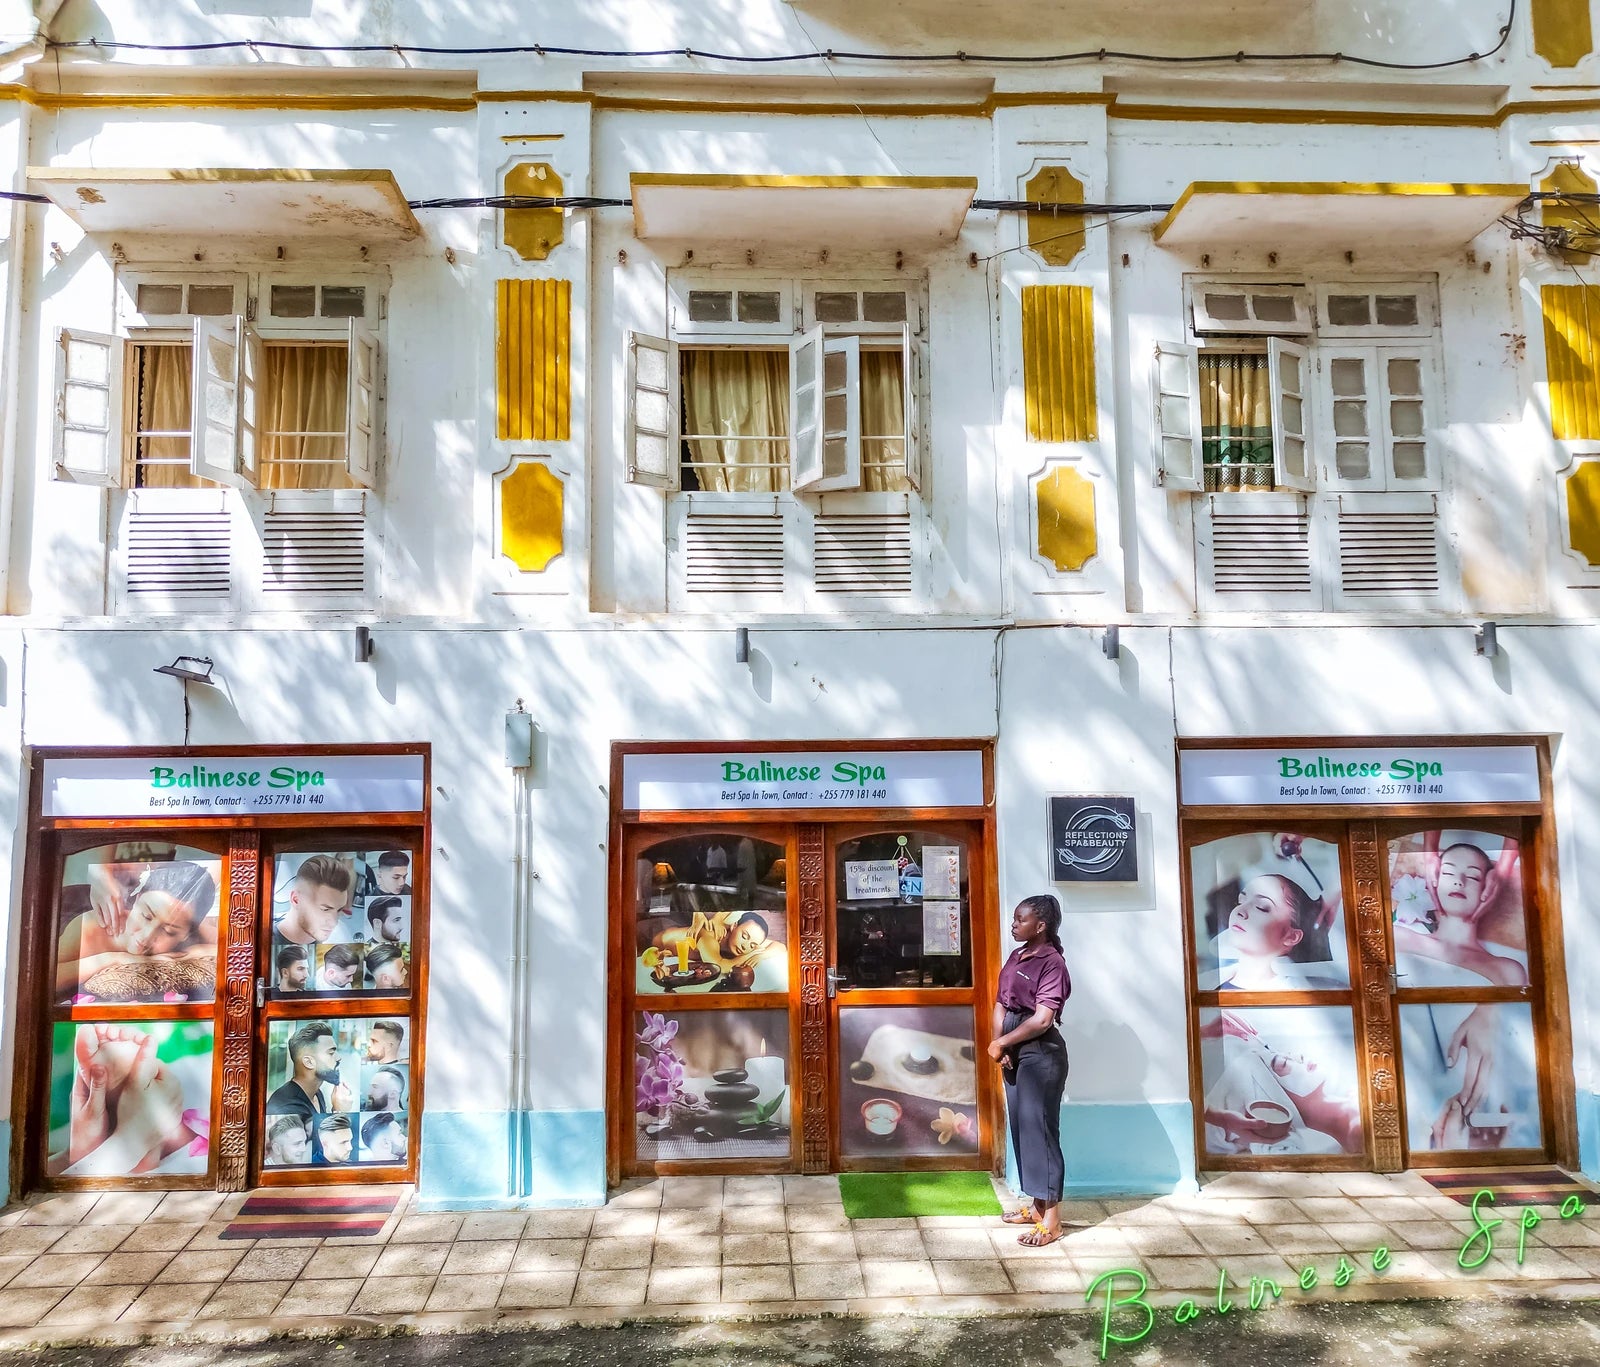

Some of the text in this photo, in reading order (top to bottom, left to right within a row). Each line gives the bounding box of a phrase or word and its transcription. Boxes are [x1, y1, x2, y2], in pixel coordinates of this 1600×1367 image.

[721, 760, 886, 786] Balinese Spa
[1277, 756, 1443, 783] Balinese Spa
[149, 765, 325, 792] Balinese Spa
[721, 790, 736, 800] Best
[737, 790, 751, 802] Spa
[752, 789, 759, 799] In
[761, 790, 780, 801] Town,
[782, 789, 808, 800] Contact
[819, 789, 838, 800] +255
[839, 789, 855, 799] 779
[857, 789, 870, 799] 181
[872, 789, 887, 799] 440
[1280, 786, 1295, 796] Best
[1296, 785, 1309, 797] Spa
[1310, 785, 1318, 796] In
[1320, 785, 1339, 797] Town,
[1341, 785, 1366, 795] Contact
[1376, 784, 1395, 795] +255
[1397, 784, 1412, 794] 779
[1413, 784, 1426, 794] 181
[1428, 784, 1443, 794] 440
[149, 796, 165, 807] Best
[167, 796, 181, 808] Spa
[182, 795, 190, 806] In
[192, 795, 212, 807] Town,
[214, 795, 242, 806] Contact
[252, 794, 273, 805] +255
[274, 794, 291, 804] 779
[292, 794, 306, 804] 181
[308, 794, 324, 804] 440
[1064, 831, 1128, 839] REFLECTIONS
[1064, 839, 1127, 847] SPA&BEAUTY
[849, 863, 895, 874] 15% discount
[862, 873, 883, 884] of the
[855, 885, 891, 895] treatments
